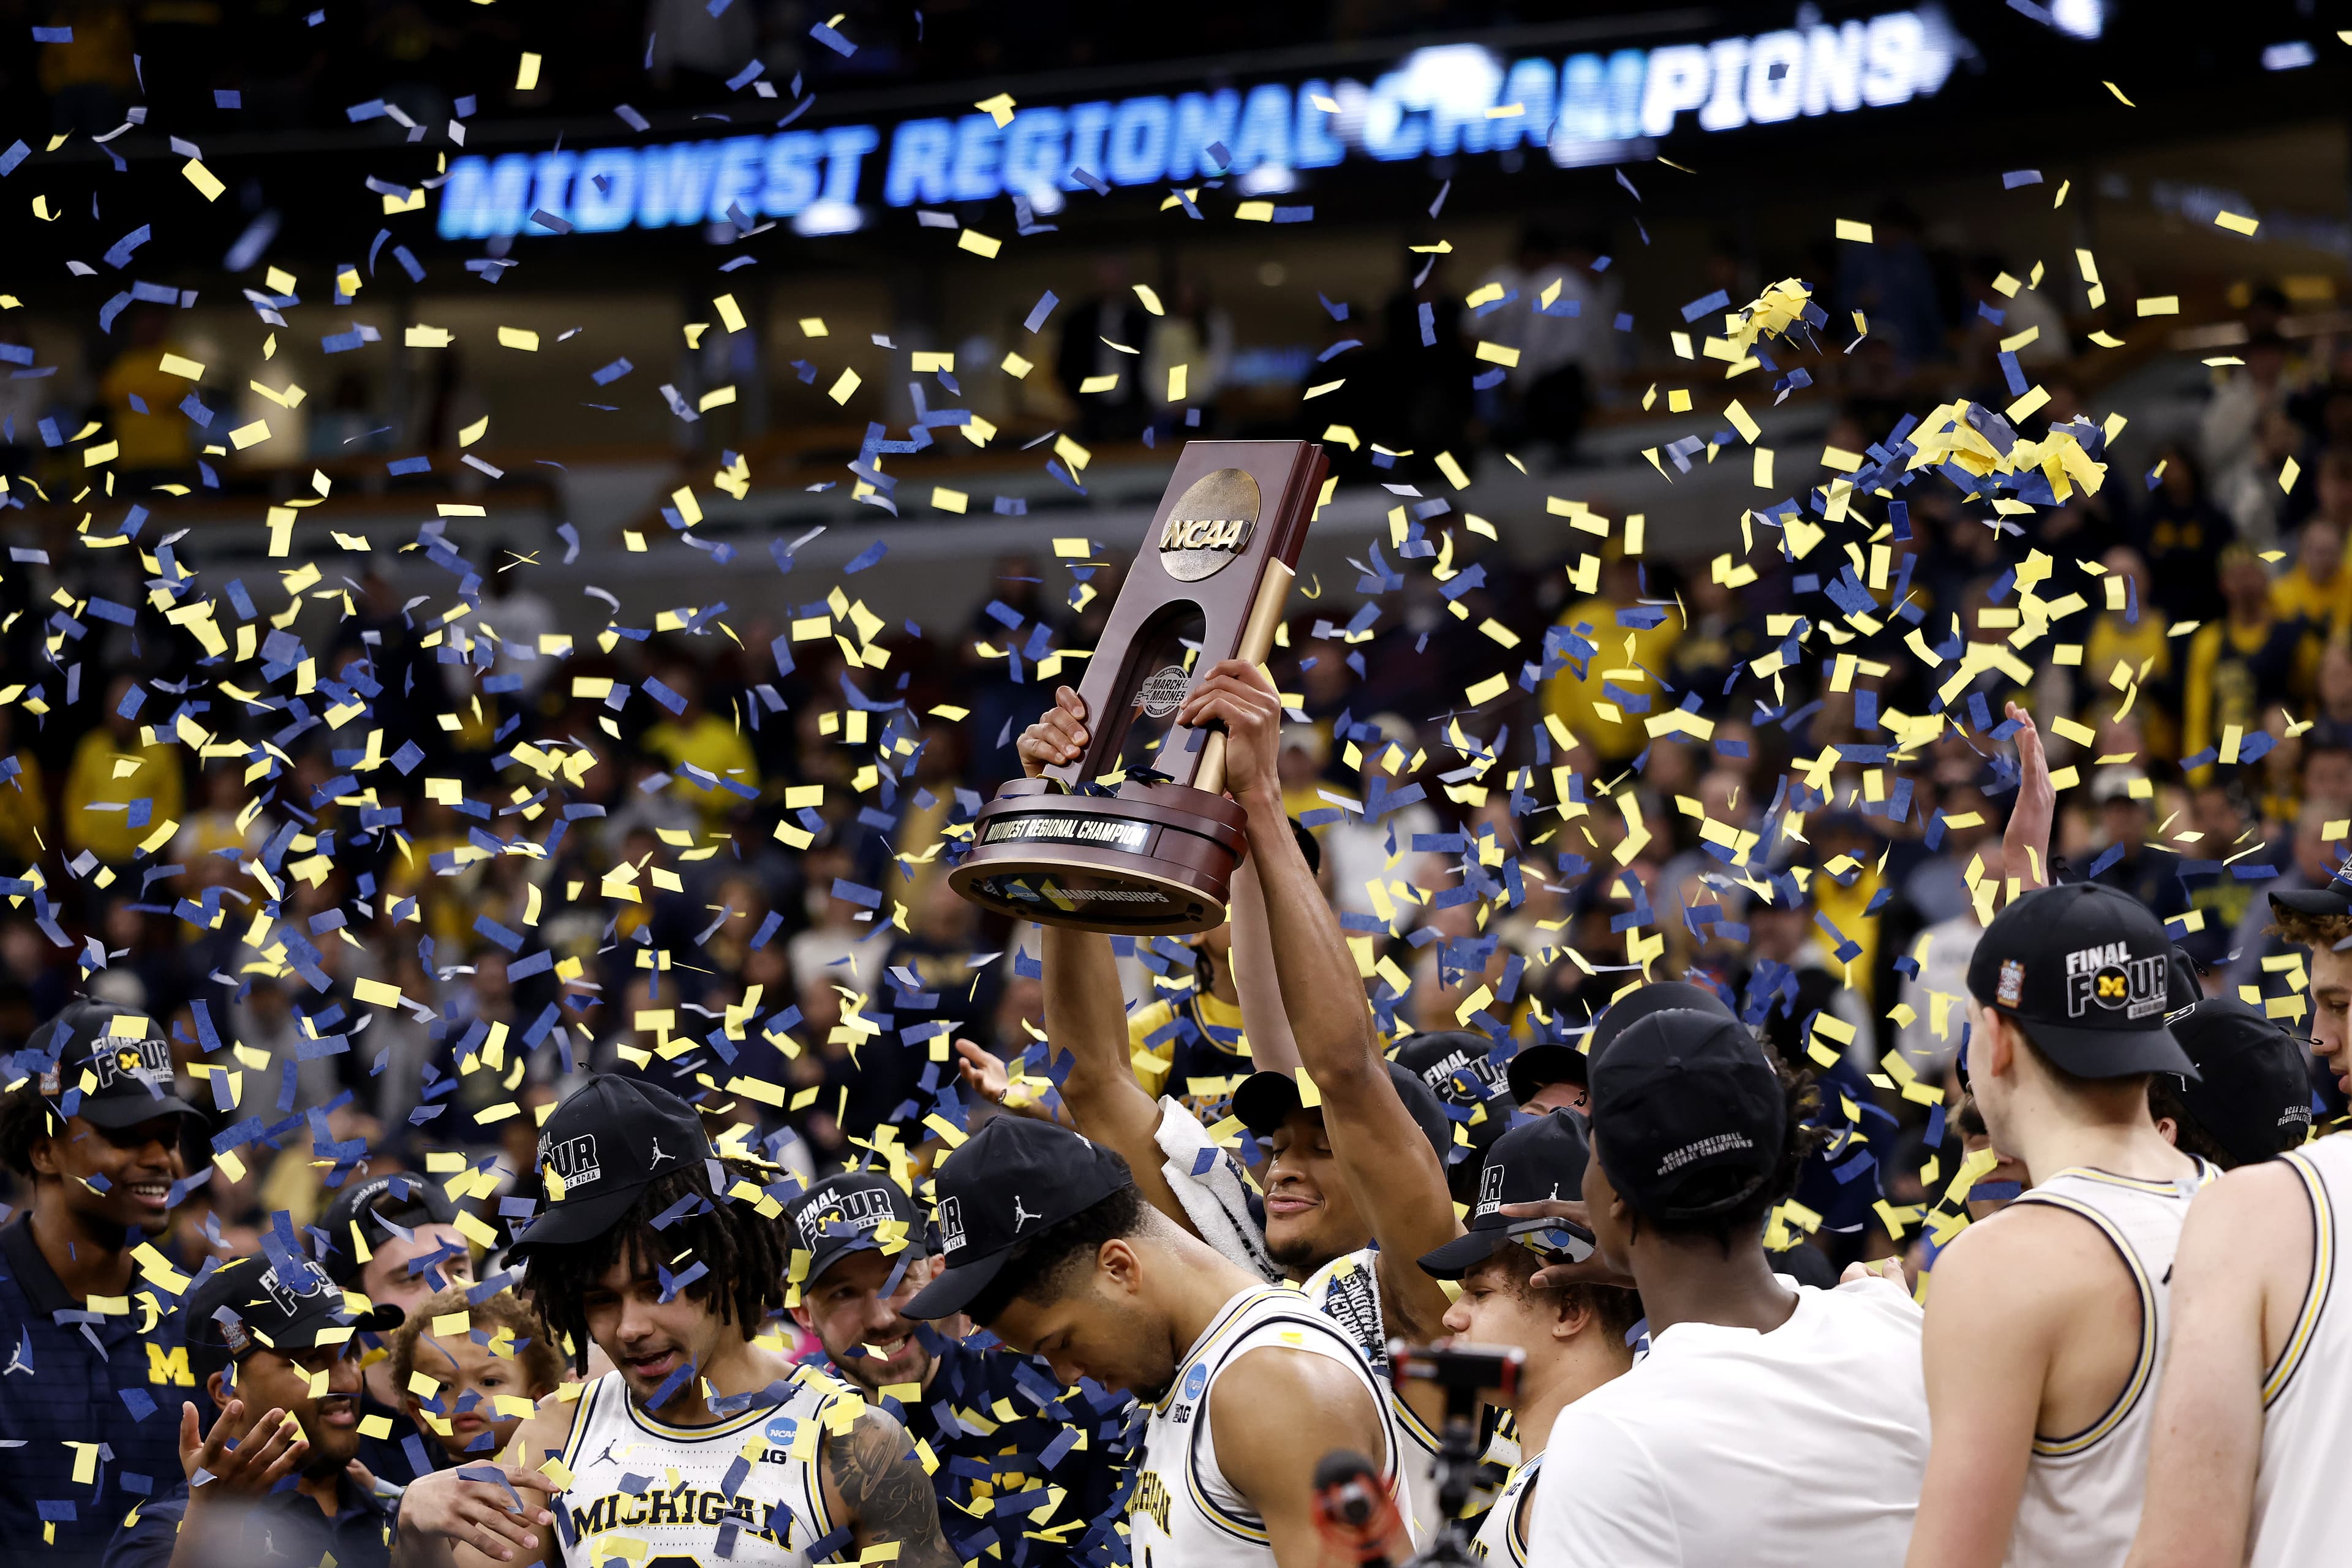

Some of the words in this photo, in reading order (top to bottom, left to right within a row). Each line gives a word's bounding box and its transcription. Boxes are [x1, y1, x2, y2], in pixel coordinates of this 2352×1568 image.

[438, 125, 878, 240] MIDWEST
[884, 79, 1345, 207] REGIONAL
[1158, 520, 1246, 553] NCAA
[1150, 690, 1186, 702] MADNES
[1152, 679, 1183, 690] MARCH
[985, 820, 1030, 842] MIDWEST
[1025, 818, 1079, 838] REGIONAL
[1076, 820, 1147, 847] CHAMPION
[1042, 888, 1170, 903] CHAMPIONSHIPS
[2065, 940, 2132, 976] FINAL
[2067, 954, 2168, 1019] FOUR
[1422, 1049, 1471, 1088] FINAL
[1657, 1151, 1699, 1176] REGIONAL
[1699, 1139, 1754, 1157] CHAMPIONS
[1662, 1147, 1686, 1164] NCAA
[1686, 1131, 1743, 1153] BASKETBALL
[576, 1170, 597, 1185] NCAA
[796, 1187, 841, 1232] FINAL
[801, 1188, 894, 1259] FOUR
[1328, 1293, 1368, 1347] MARCH
[145, 1342, 195, 1387] M
[758, 1448, 787, 1464] 1G
[571, 1490, 796, 1553] MICHIGAN
